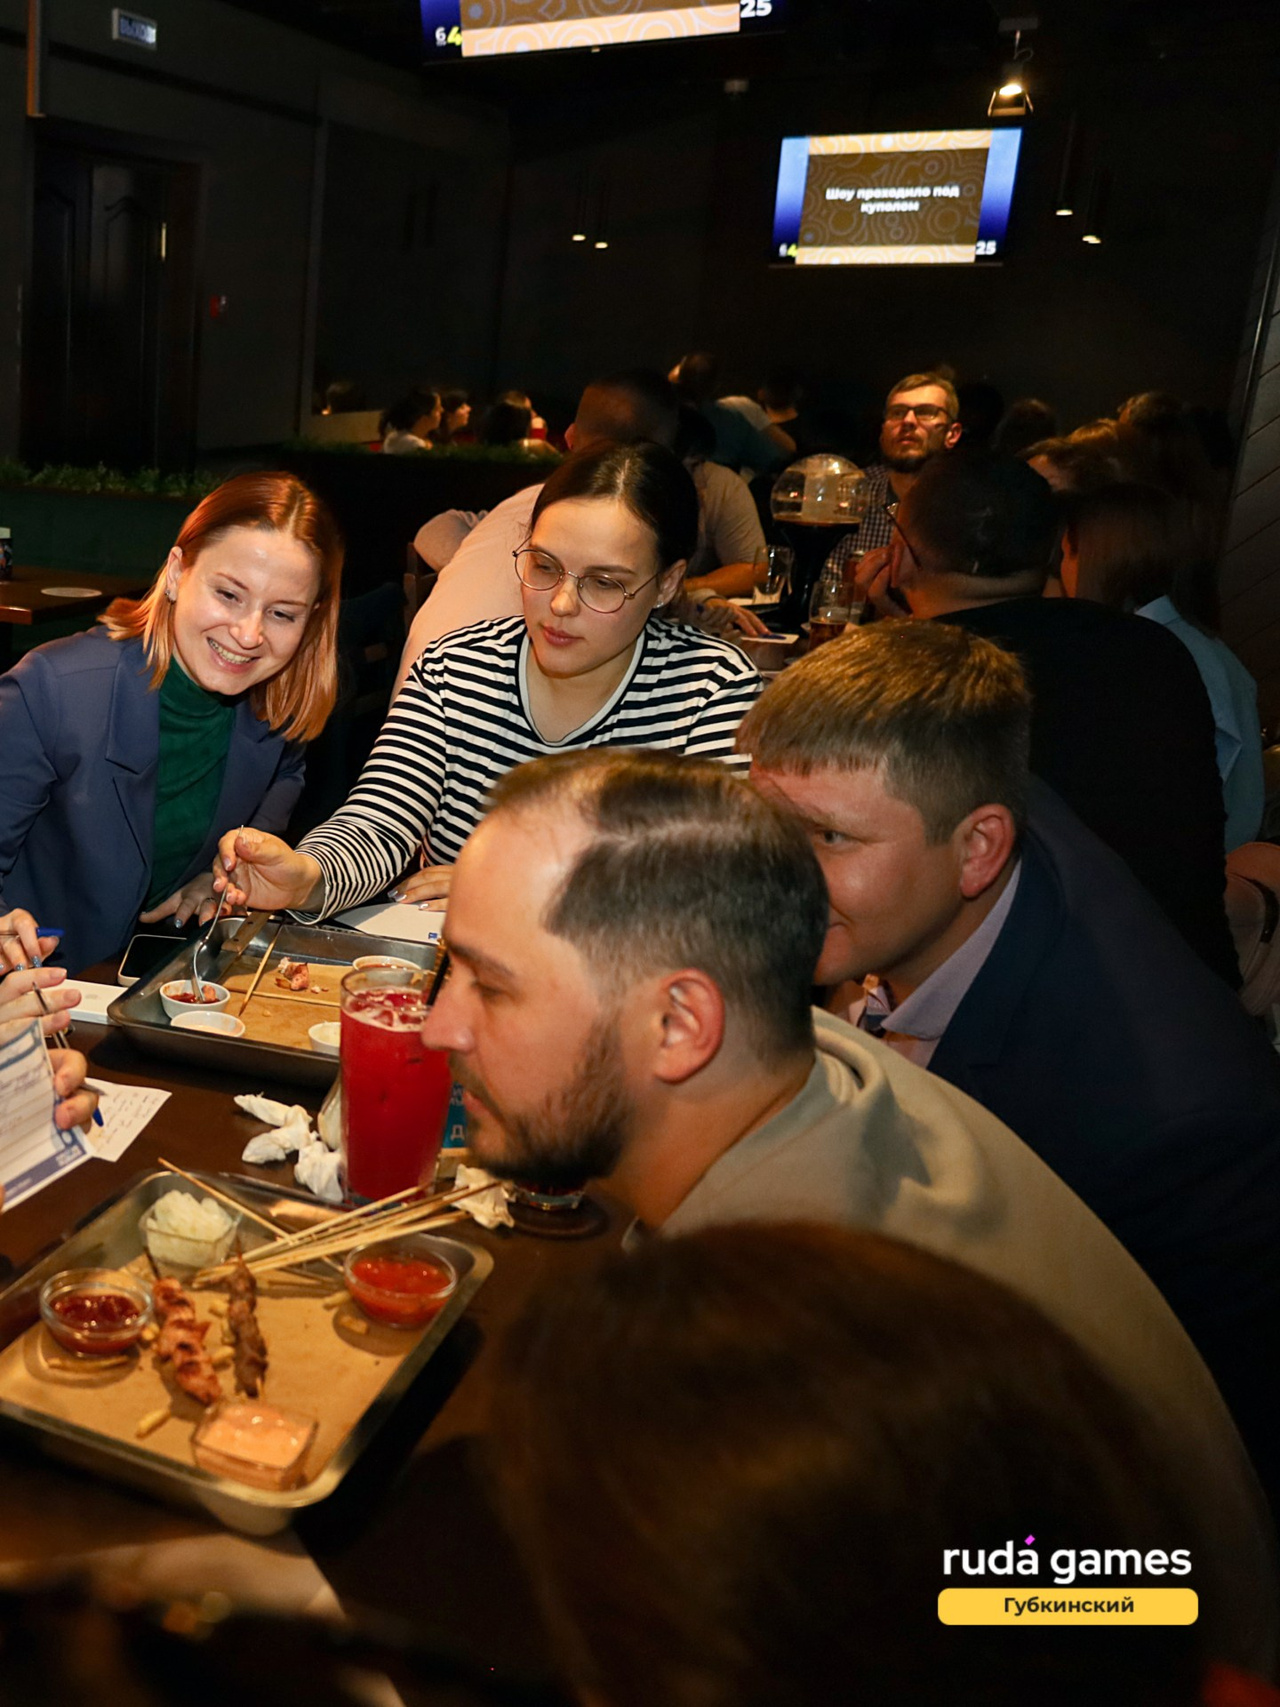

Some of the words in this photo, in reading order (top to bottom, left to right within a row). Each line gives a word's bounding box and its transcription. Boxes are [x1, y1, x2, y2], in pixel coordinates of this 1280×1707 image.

[740, 0, 772, 18] 25
[825, 187, 855, 202] Шоу
[856, 186, 932, 201] проходило
[932, 184, 960, 198] под
[860, 201, 920, 215] куполом
[975, 240, 997, 255] 25
